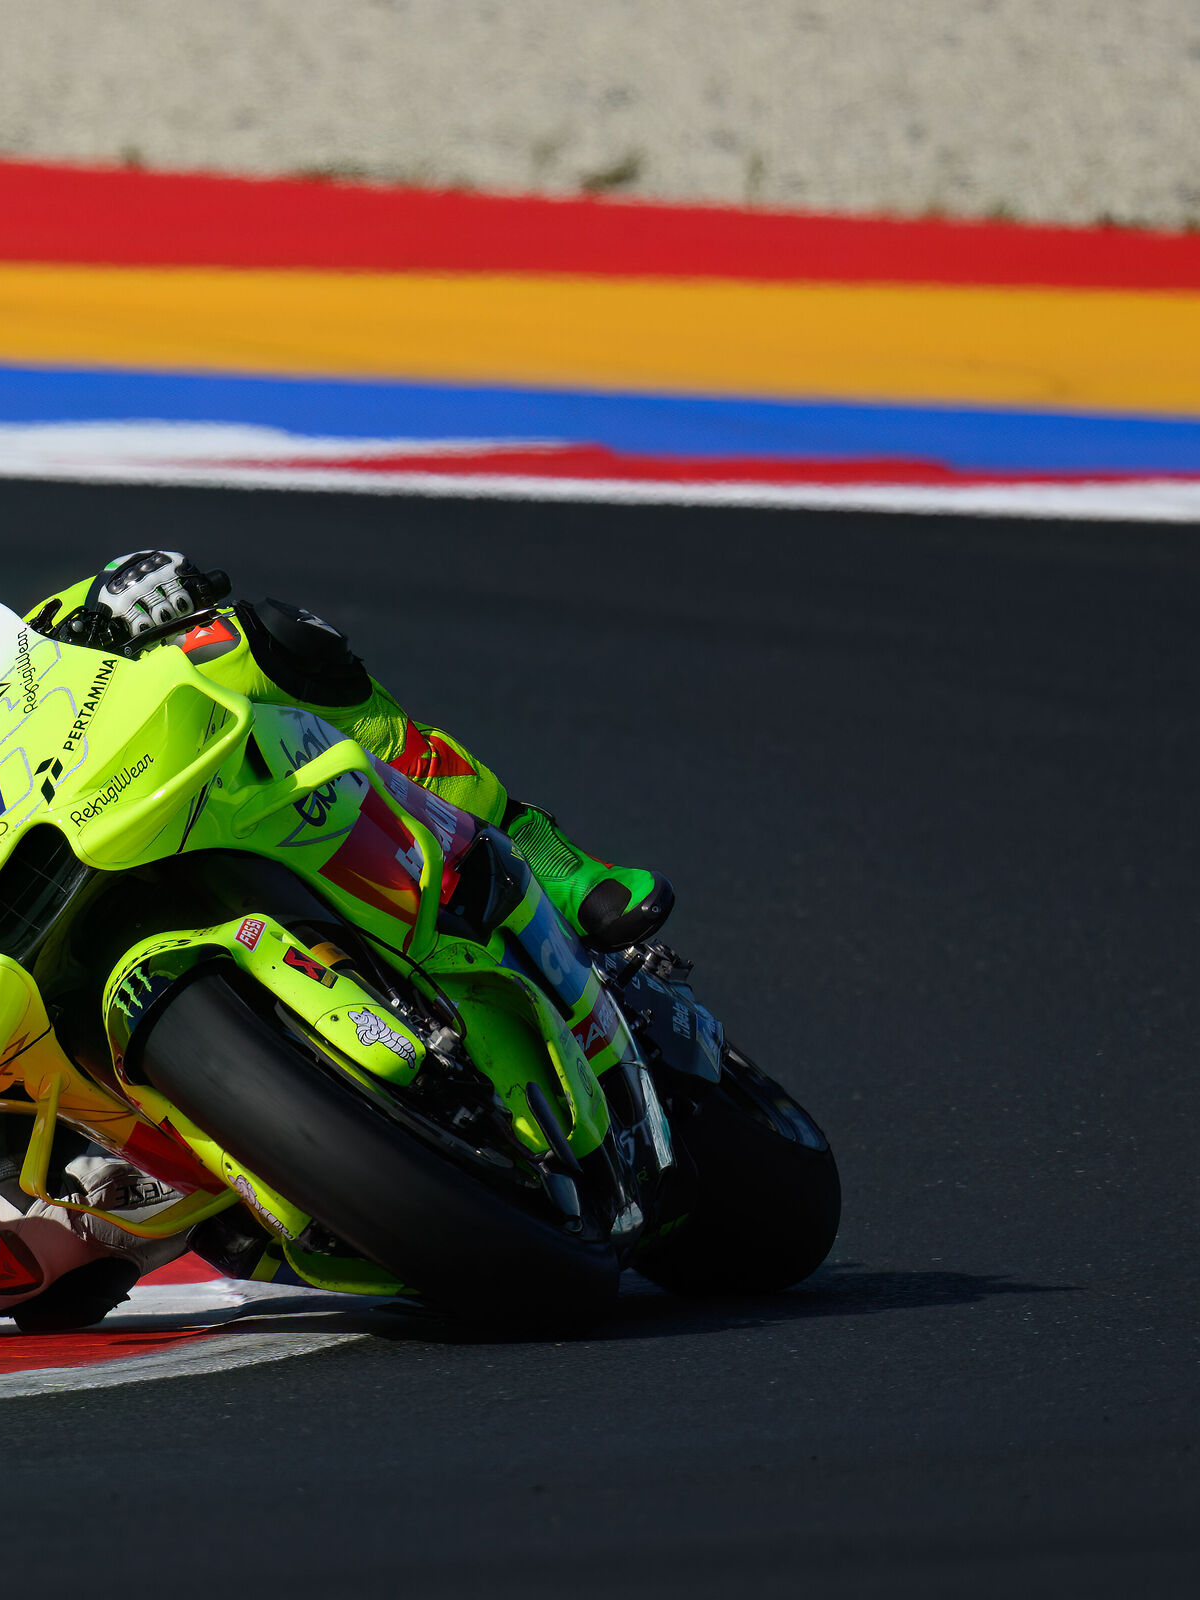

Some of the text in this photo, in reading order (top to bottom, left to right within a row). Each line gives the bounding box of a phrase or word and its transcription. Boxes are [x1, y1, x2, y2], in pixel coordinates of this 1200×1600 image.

[15, 627, 39, 714] RefrigiWear
[63, 659, 118, 752] PERTAMINA
[70, 753, 154, 828] RefrigiWear
[240, 920, 262, 946] FASSI
